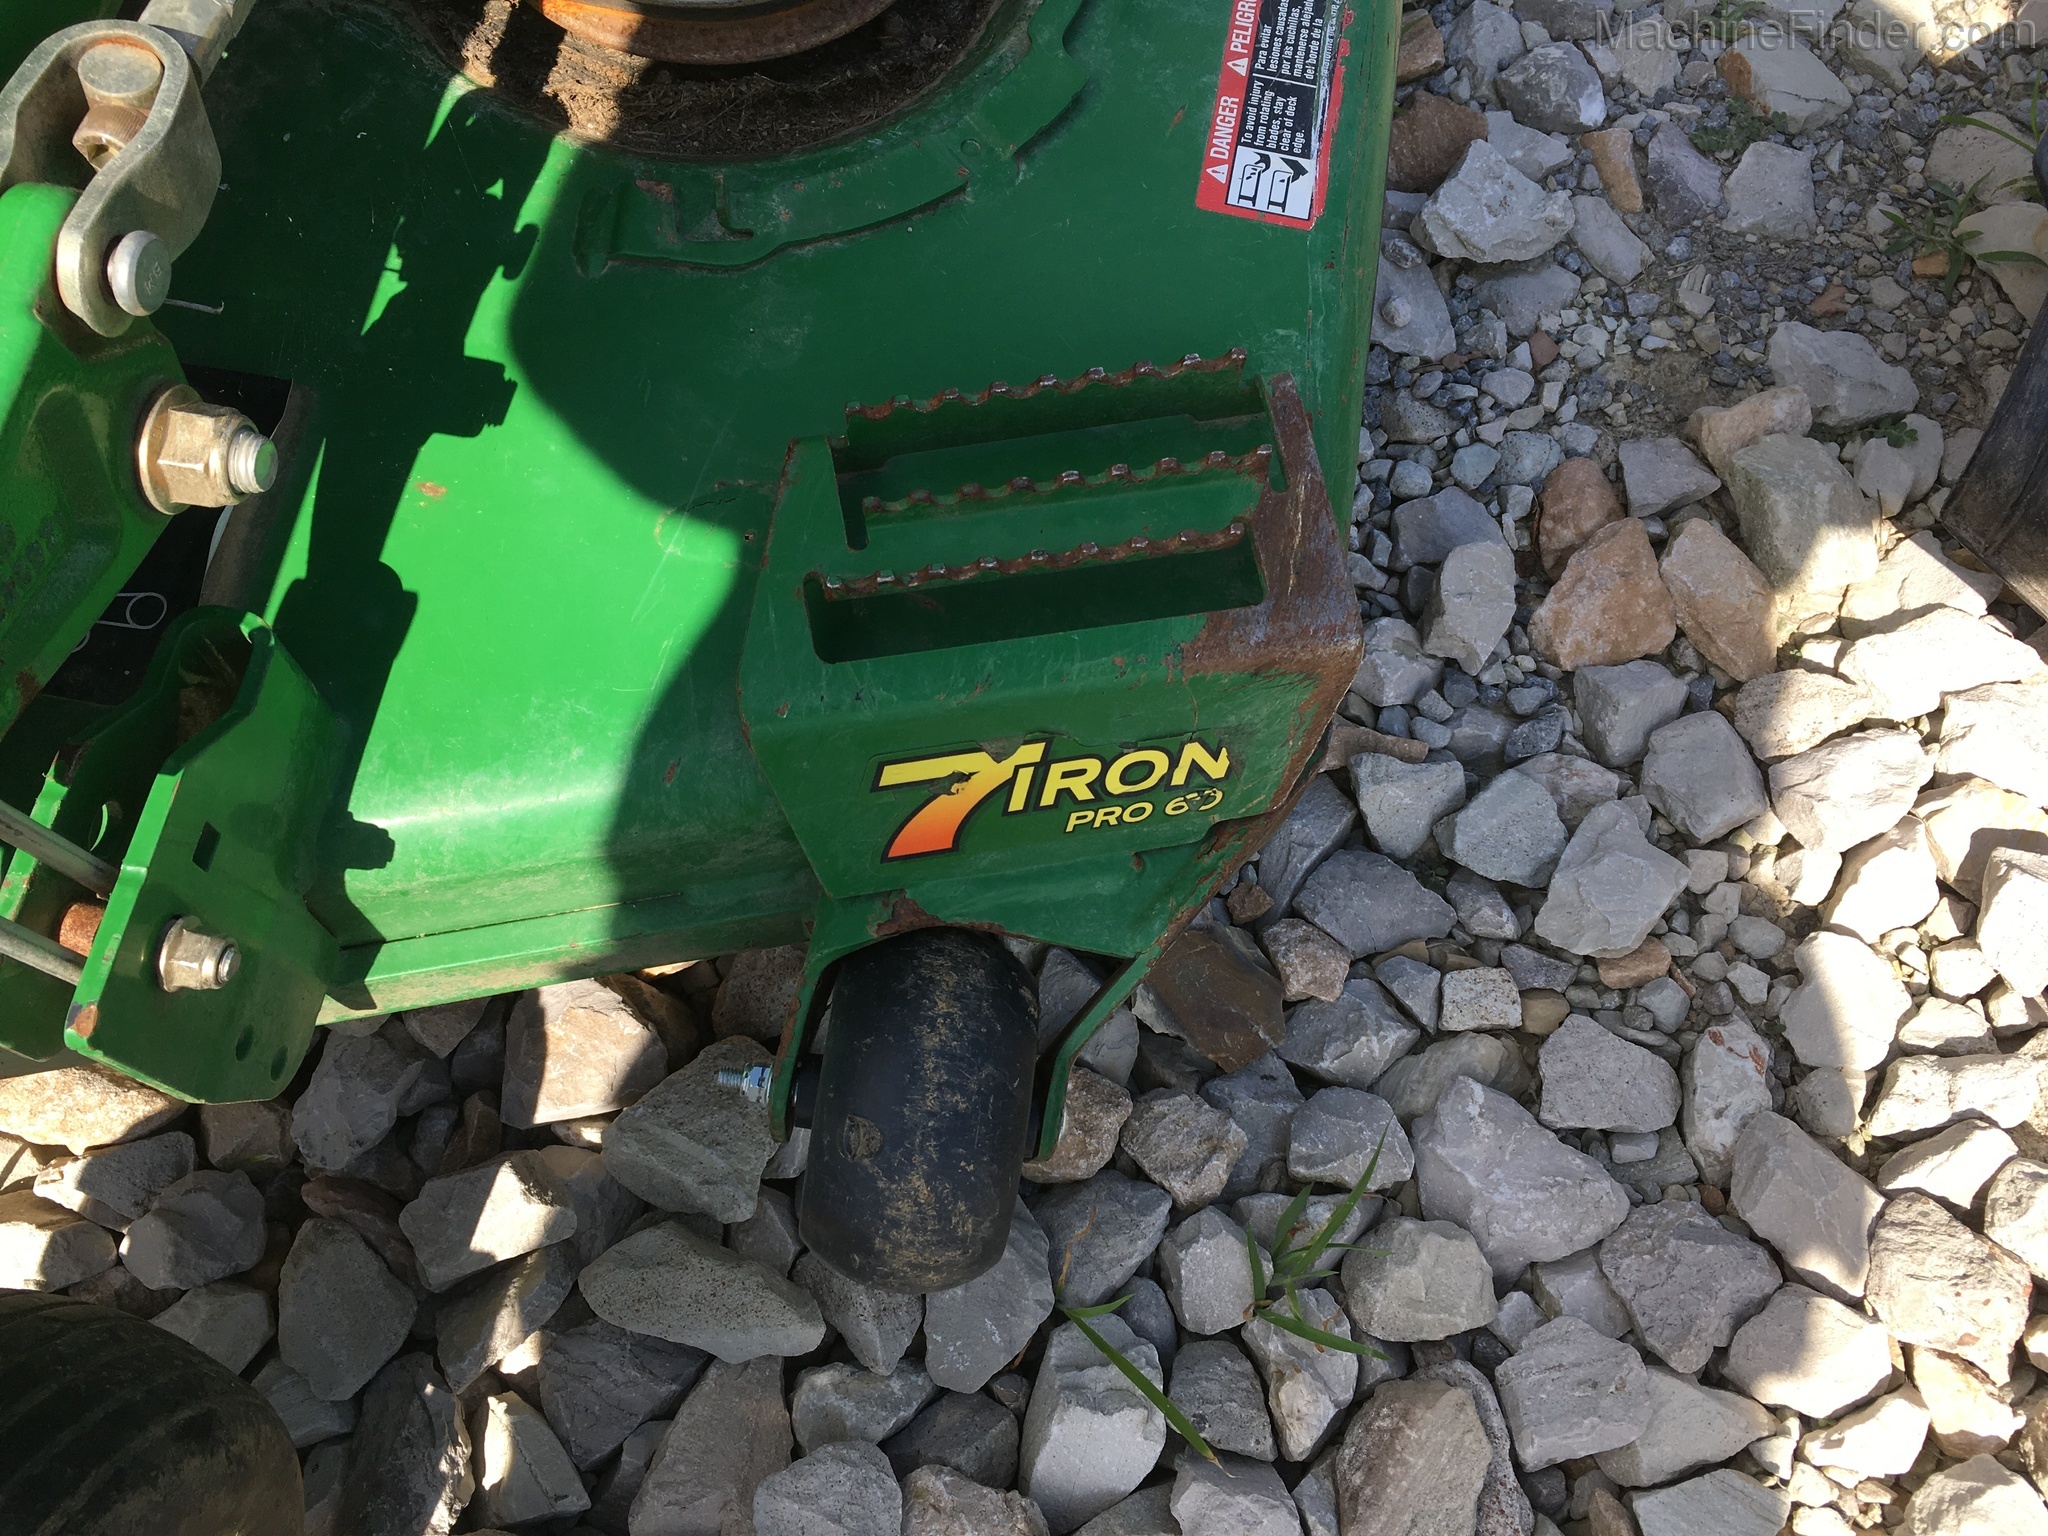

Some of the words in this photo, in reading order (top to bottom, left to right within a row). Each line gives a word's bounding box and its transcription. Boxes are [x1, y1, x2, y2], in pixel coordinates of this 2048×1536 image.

[1286, 5, 1301, 44] cuchillas,
[1300, 0, 1315, 27] alejad
[1312, 18, 1323, 27] la
[1229, 0, 1261, 54] PELIGR
[1259, 24, 1272, 48] evitar
[1310, 27, 1322, 39] de
[1254, 50, 1268, 70] Para
[1266, 36, 1283, 72] lesiones
[1282, 45, 1294, 59] las
[1293, 28, 1309, 77] mantenerse
[1306, 40, 1320, 65] borde
[1281, 59, 1292, 75] por
[1304, 62, 1315, 80] del
[1248, 80, 1264, 105] injury
[1259, 90, 1275, 124] rotating
[1273, 95, 1287, 115] stay
[1286, 96, 1298, 117] deck
[1209, 95, 1240, 160] DANGER
[1245, 107, 1257, 131] avoid
[1284, 117, 1294, 127] of
[1240, 132, 1253, 143] To
[1254, 126, 1267, 147] from
[1266, 117, 1281, 149] blades,
[1279, 129, 1292, 151] clear
[1292, 129, 1306, 154] edge.
[1065, 801, 1154, 833] PRO
